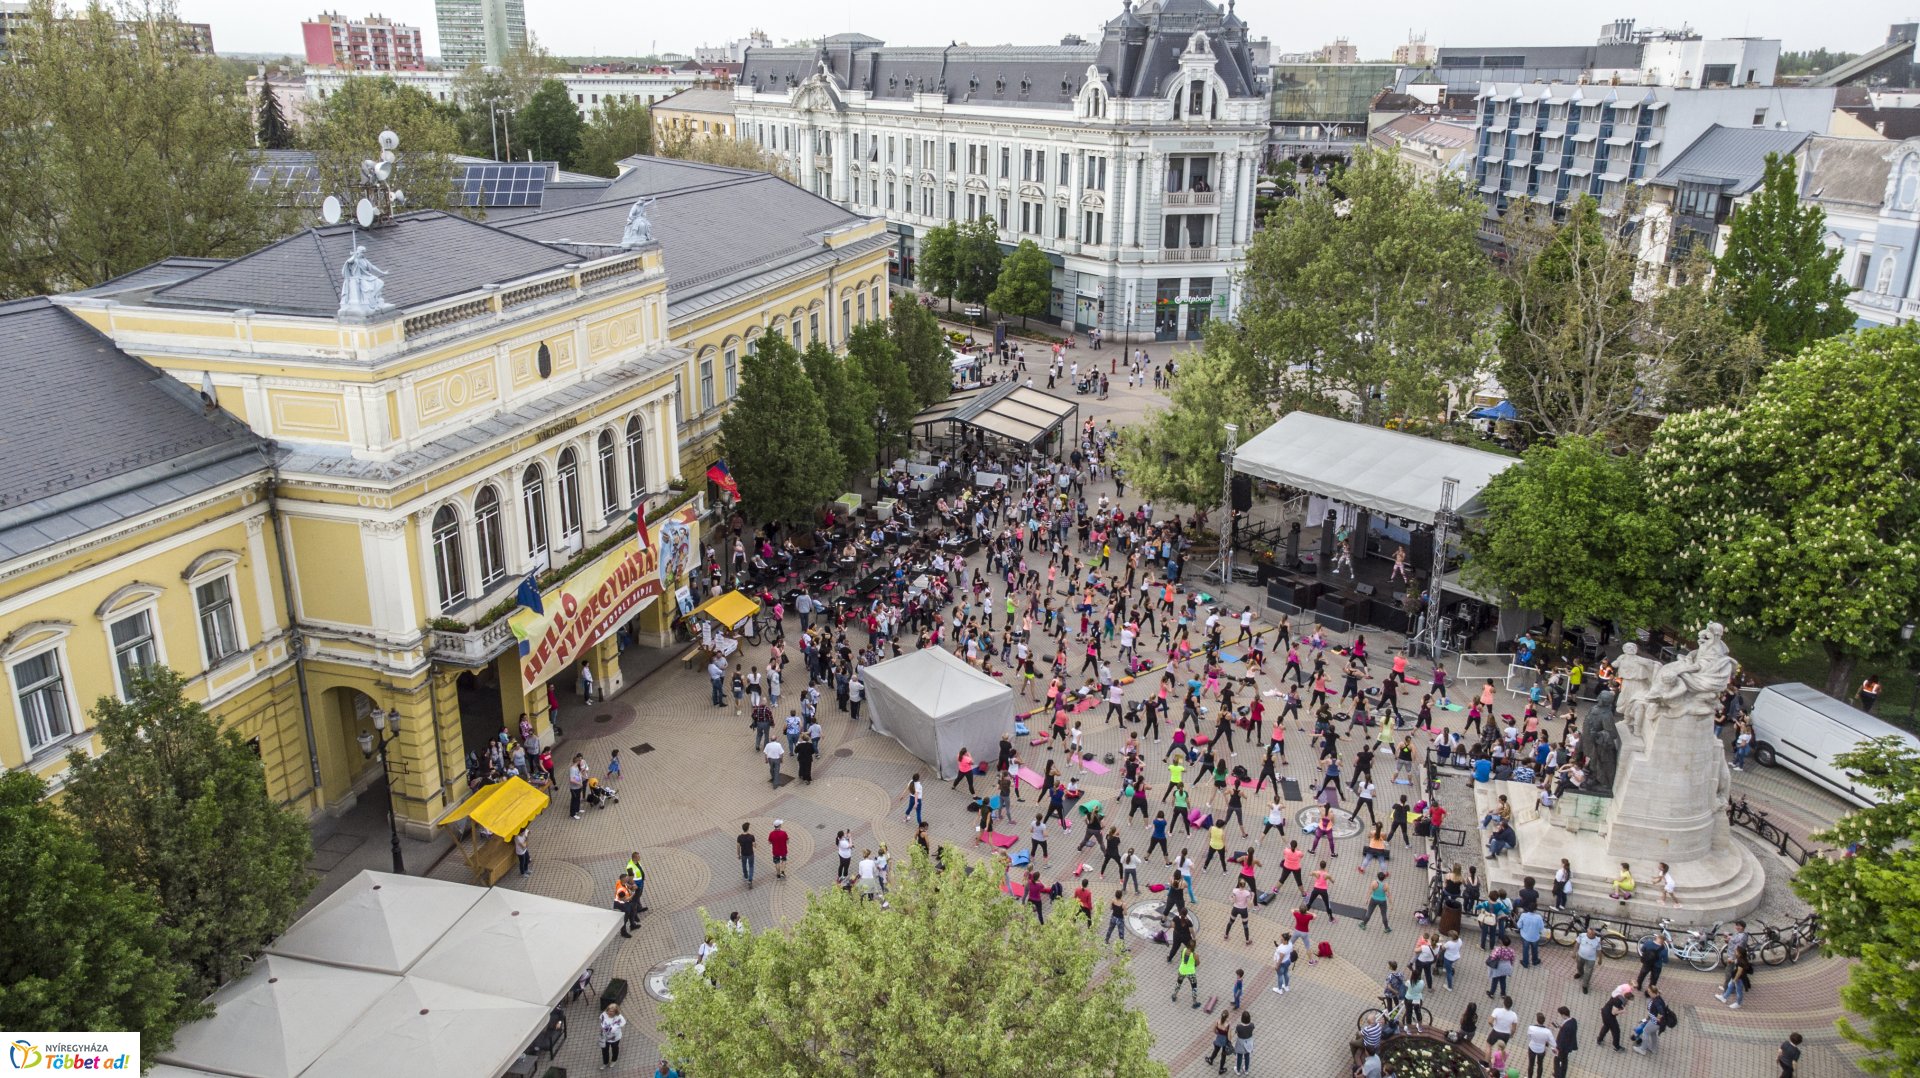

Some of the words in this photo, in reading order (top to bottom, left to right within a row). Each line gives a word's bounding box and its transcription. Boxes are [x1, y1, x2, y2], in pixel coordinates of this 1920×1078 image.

[523, 589, 578, 686] HELLÓ
[555, 542, 659, 666] NYÍREGYHÁZA!
[594, 629, 601, 639] A
